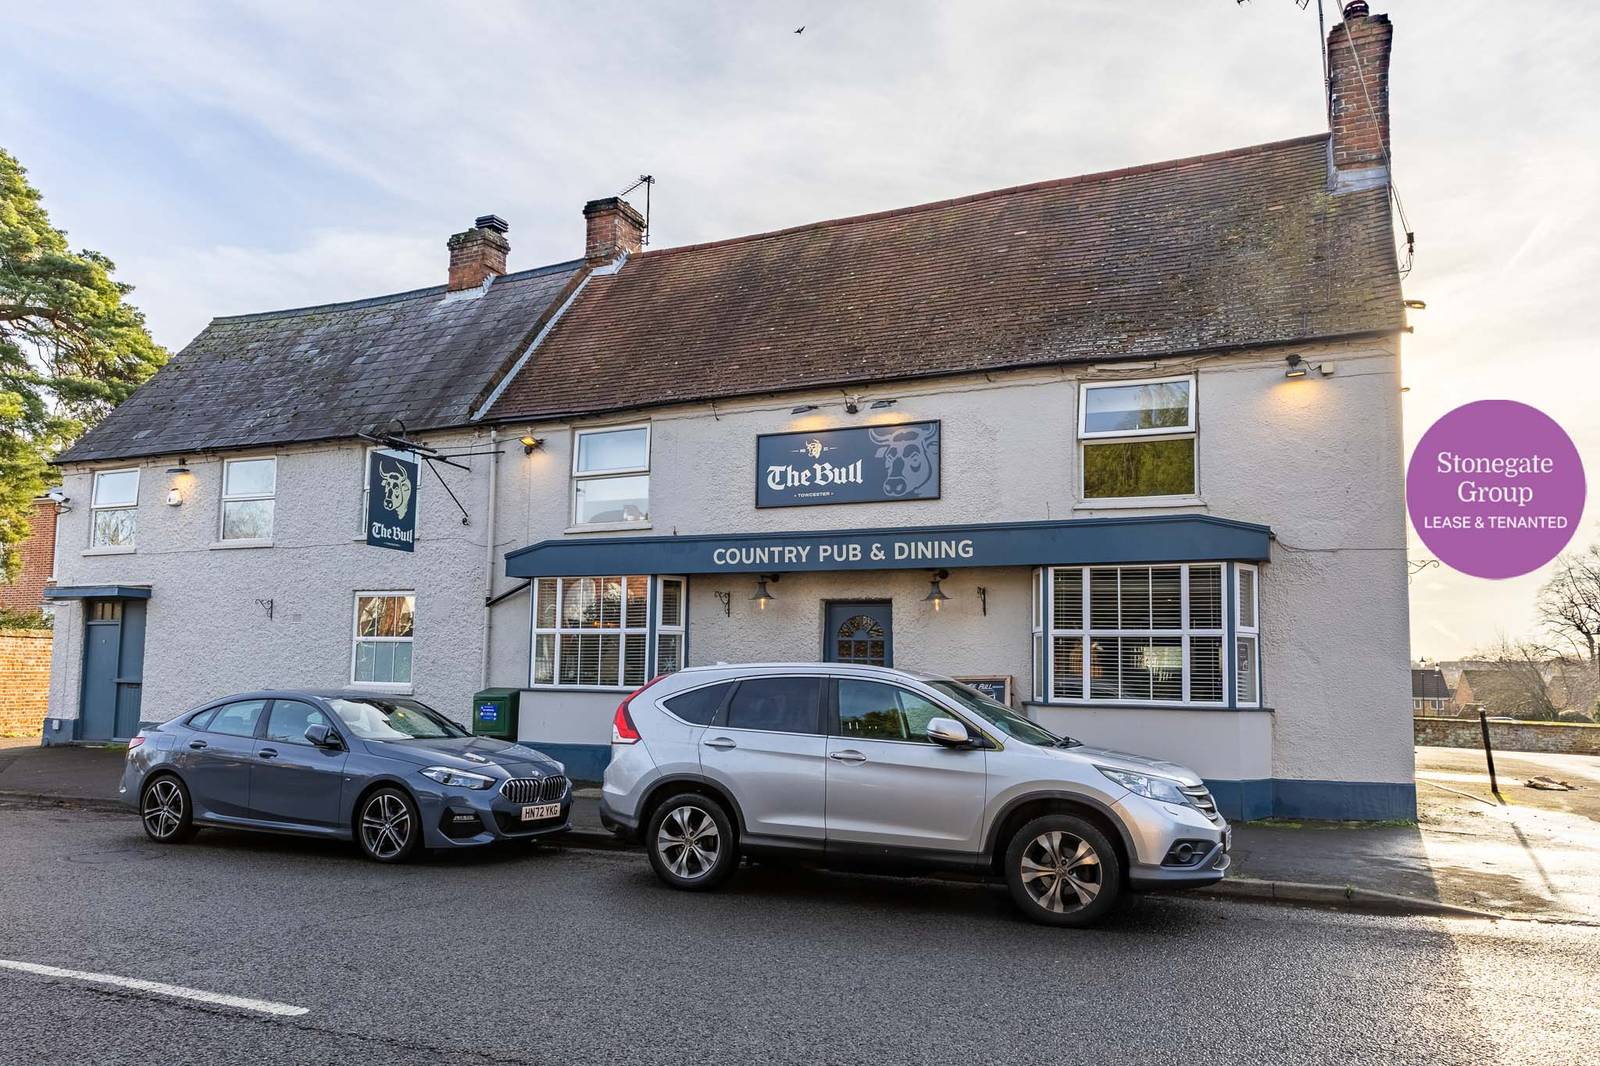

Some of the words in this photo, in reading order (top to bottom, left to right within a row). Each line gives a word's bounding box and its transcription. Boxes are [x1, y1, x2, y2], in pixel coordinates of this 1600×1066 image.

[767, 465, 811, 490] The
[812, 459, 864, 486] Bull
[372, 522, 391, 538] The
[392, 527, 413, 543] Bull
[713, 545, 810, 565] COUNTRY
[819, 544, 862, 562] PUB
[869, 543, 886, 561] &
[894, 539, 974, 560] DINING
[525, 807, 544, 818] HN72
[545, 805, 558, 816] YKG
